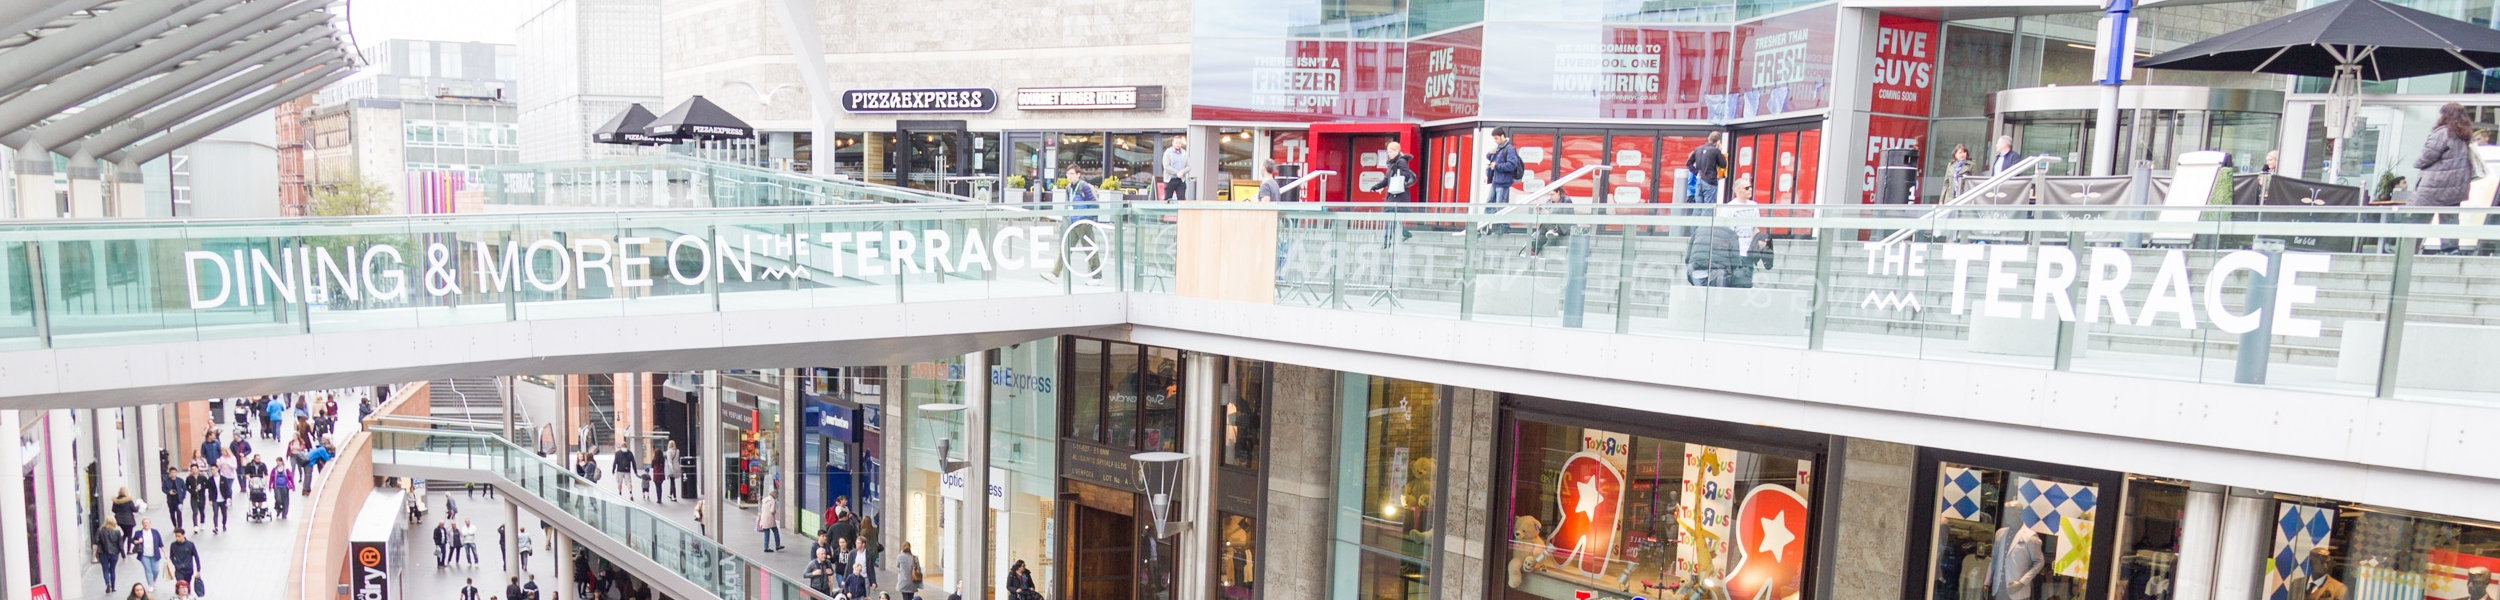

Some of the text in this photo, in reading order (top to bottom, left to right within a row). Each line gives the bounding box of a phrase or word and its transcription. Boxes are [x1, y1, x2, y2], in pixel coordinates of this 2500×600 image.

[1599, 43, 1643, 53] COMING
[1646, 44, 1662, 53] TO
[1755, 28, 1809, 50] FRESHER THAN
[1878, 27, 1928, 58] FIVE
[1253, 56, 1340, 68] THERE ISN'T A
[1429, 46, 1455, 73] FIVE
[1556, 58, 1658, 68] LIVERPOOL ONE
[1754, 47, 1806, 87] FRESH
[1255, 70, 1337, 92] FREEZER
[1552, 73, 1659, 93] NOW HIRING
[1872, 57, 1930, 88] GUYS
[1425, 71, 1455, 98] GUYS
[1878, 88, 1917, 102] COMING SOON
[850, 90, 983, 110] PIZZAEXPRESS
[1018, 90, 1136, 106] GOURMET BURGER KITCHEN
[1251, 95, 1340, 107] IN THE JOINT
[692, 125, 744, 136] PIZZAEXPRESS
[183, 225, 1056, 311] DINING & MORE ON THE TERRACE
[1863, 242, 2332, 338] THE TERRACE
[1005, 366, 1052, 394] Express
[729, 410, 743, 421] PERFUME
